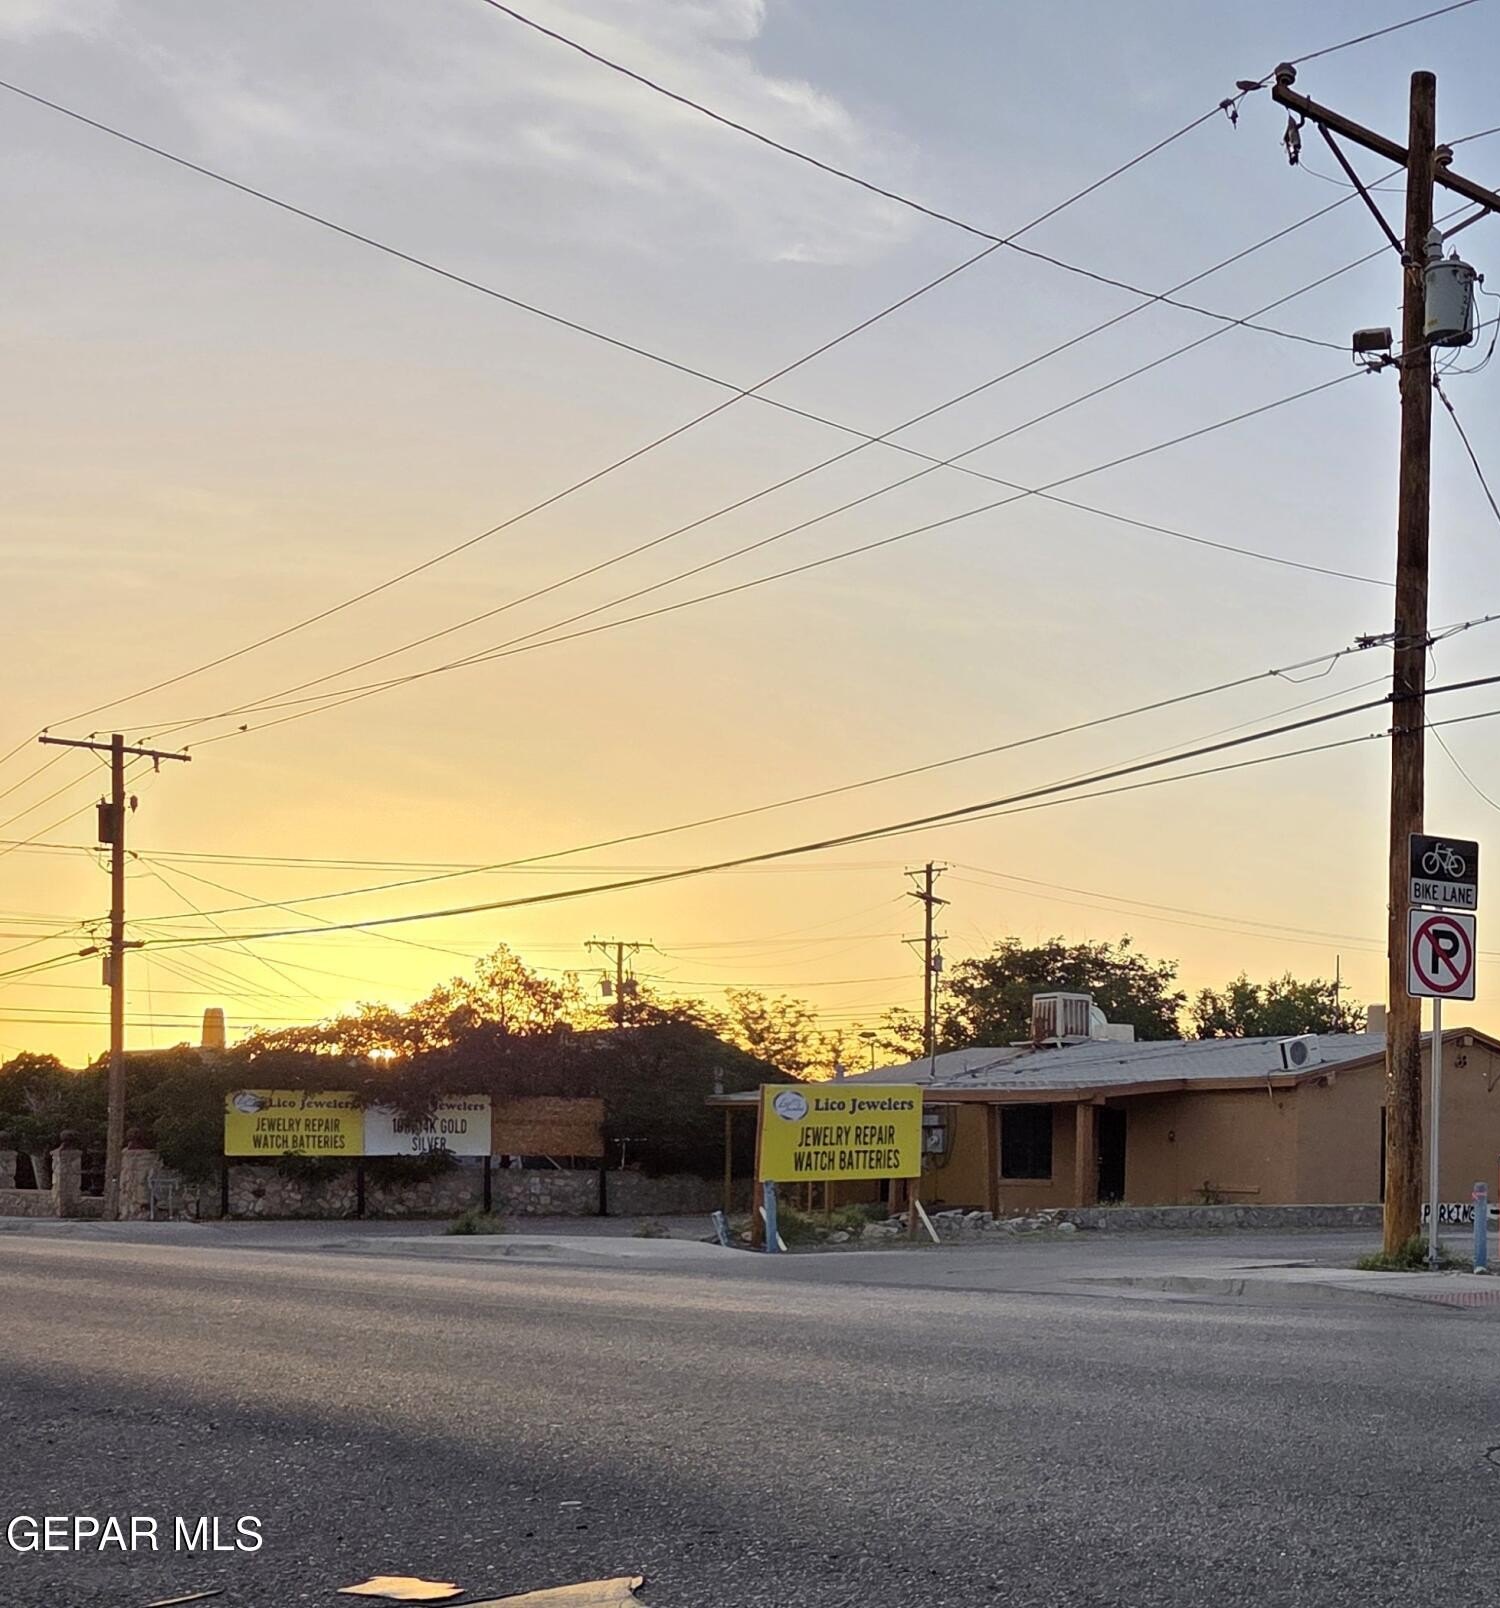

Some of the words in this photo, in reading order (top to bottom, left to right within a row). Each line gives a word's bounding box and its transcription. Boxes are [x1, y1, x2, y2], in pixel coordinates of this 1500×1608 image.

[1414, 882, 1439, 901] BIKE
[1443, 886, 1473, 905] LANE
[269, 1097, 296, 1109] Lico
[814, 1098, 846, 1111] Lico
[849, 1097, 915, 1115] Jewelers
[255, 1117, 302, 1133] JEWELRY
[304, 1117, 341, 1132] REPAIR
[440, 1118, 467, 1134] GOLD
[252, 1134, 289, 1149] WATCH
[291, 1134, 346, 1149] BATTERIES
[412, 1136, 447, 1152] SILVER
[798, 1125, 852, 1147] JEWELRY
[854, 1125, 896, 1146] REPAIR
[793, 1150, 836, 1172] WATCH
[838, 1149, 900, 1170] BATTERIES
[1424, 1203, 1475, 1223] PRKING
